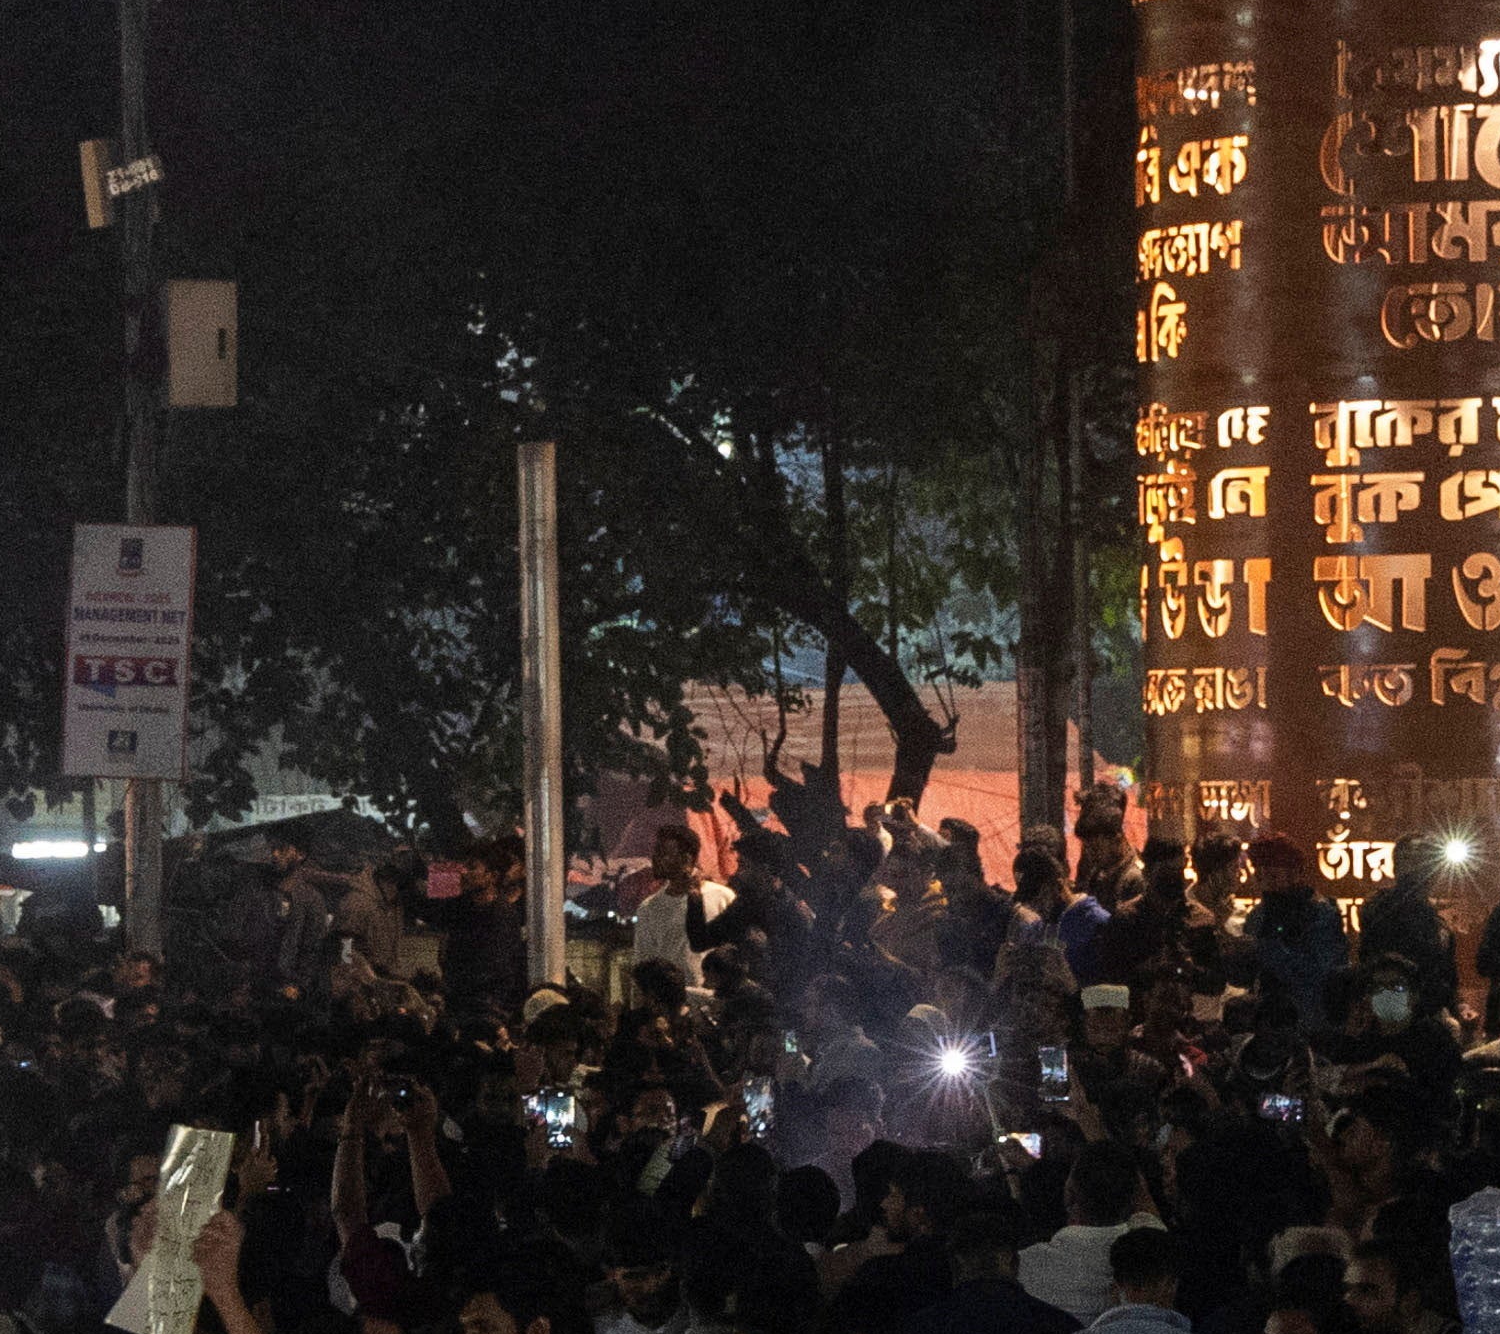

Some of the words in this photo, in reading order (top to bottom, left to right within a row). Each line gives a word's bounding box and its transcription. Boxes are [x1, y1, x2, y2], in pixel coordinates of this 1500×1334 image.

[1169, 133, 1248, 197] এক
[1309, 399, 1483, 467] বুকের
[1208, 466, 1271, 520] নে
[1310, 470, 1425, 544] বুক
[1320, 662, 1417, 707] কত
